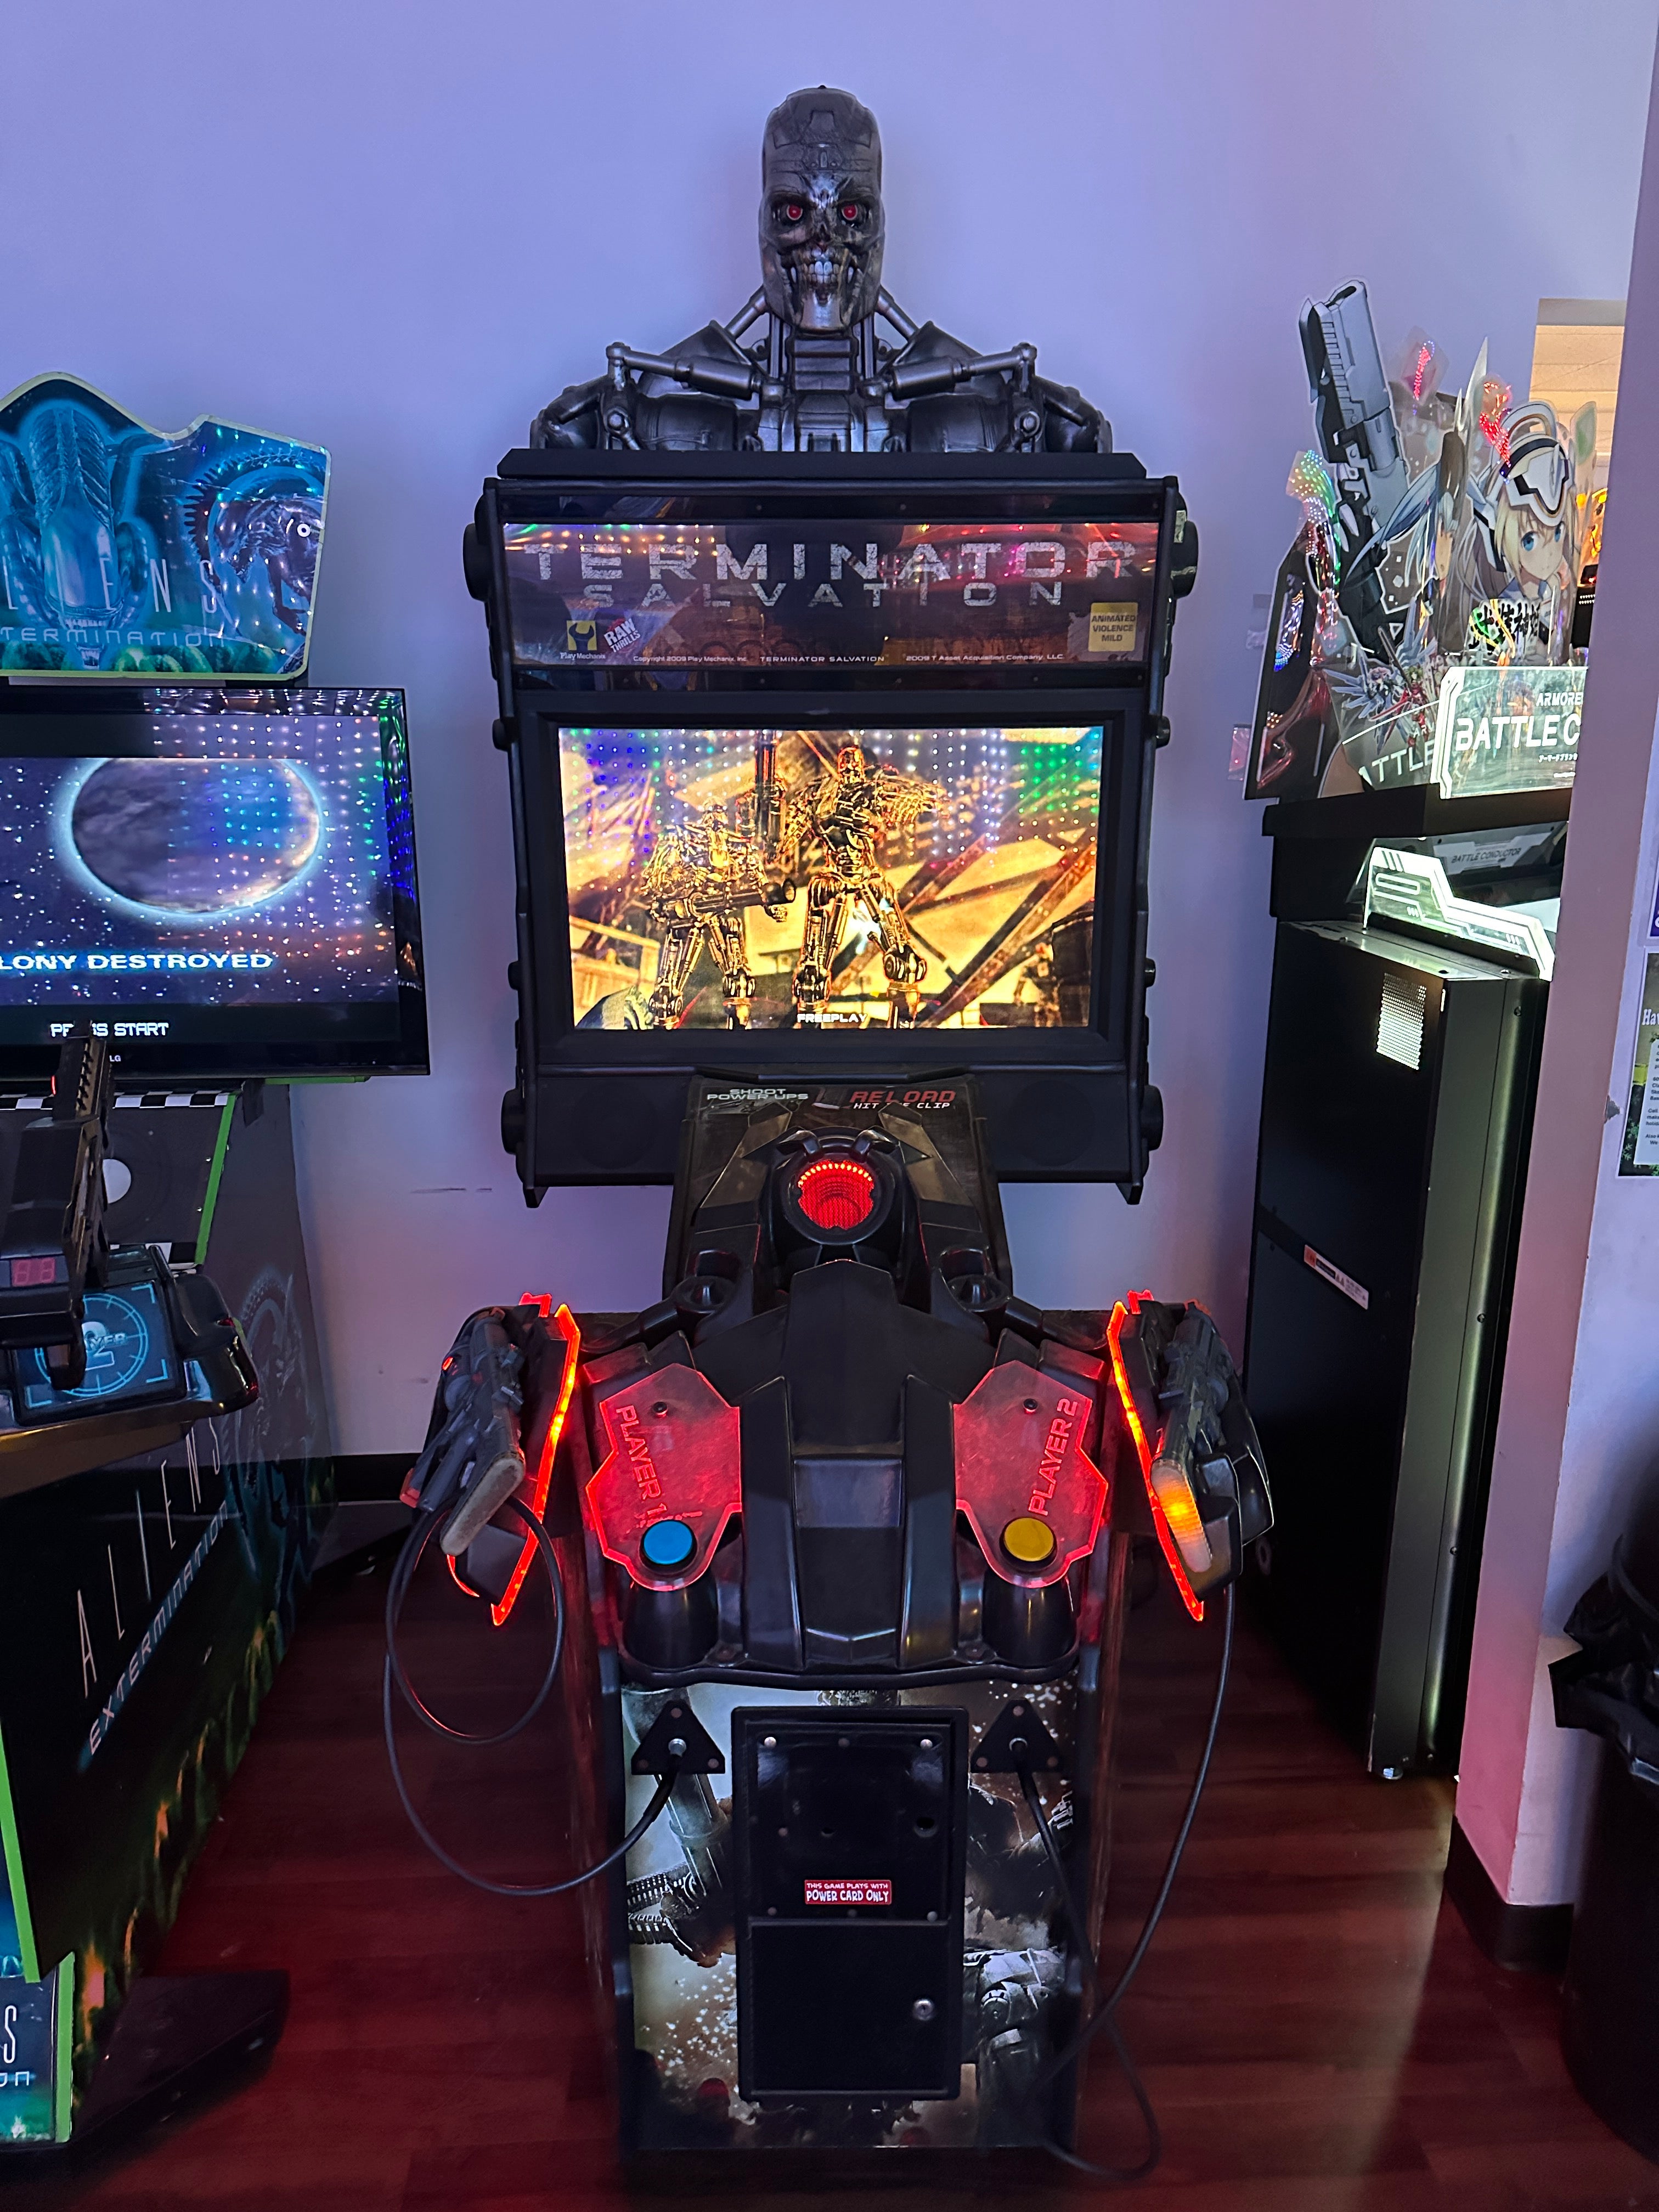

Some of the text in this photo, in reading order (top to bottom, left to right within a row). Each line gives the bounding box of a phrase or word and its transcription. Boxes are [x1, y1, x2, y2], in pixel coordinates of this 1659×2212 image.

[524, 541, 1137, 580] TERMINATOR
[583, 582, 1063, 607] SALVATION
[604, 618, 635, 646] RAW
[610, 630, 641, 653] THRILLS
[1536, 692, 1583, 707] ARMORE
[1455, 714, 1561, 751] BATTLE
[1452, 853, 1480, 864] BATTLE
[1480, 848, 1521, 860] CONDUCTOR
[87, 953, 273, 970] DESTROYED
[797, 1013, 868, 1023] FREEPLAY
[1642, 1009, 1659, 1025] Ha
[114, 1022, 169, 1036] START
[849, 1090, 956, 1103] RELOAD
[616, 1405, 667, 1515] PLAYER 1
[1028, 1398, 1078, 1516] PLAYER 2
[77, 1417, 220, 1699] ALIENS
[89, 1500, 228, 1756] EXTERMINATION
[806, 1889, 889, 1903] POWER CARD ONLY
